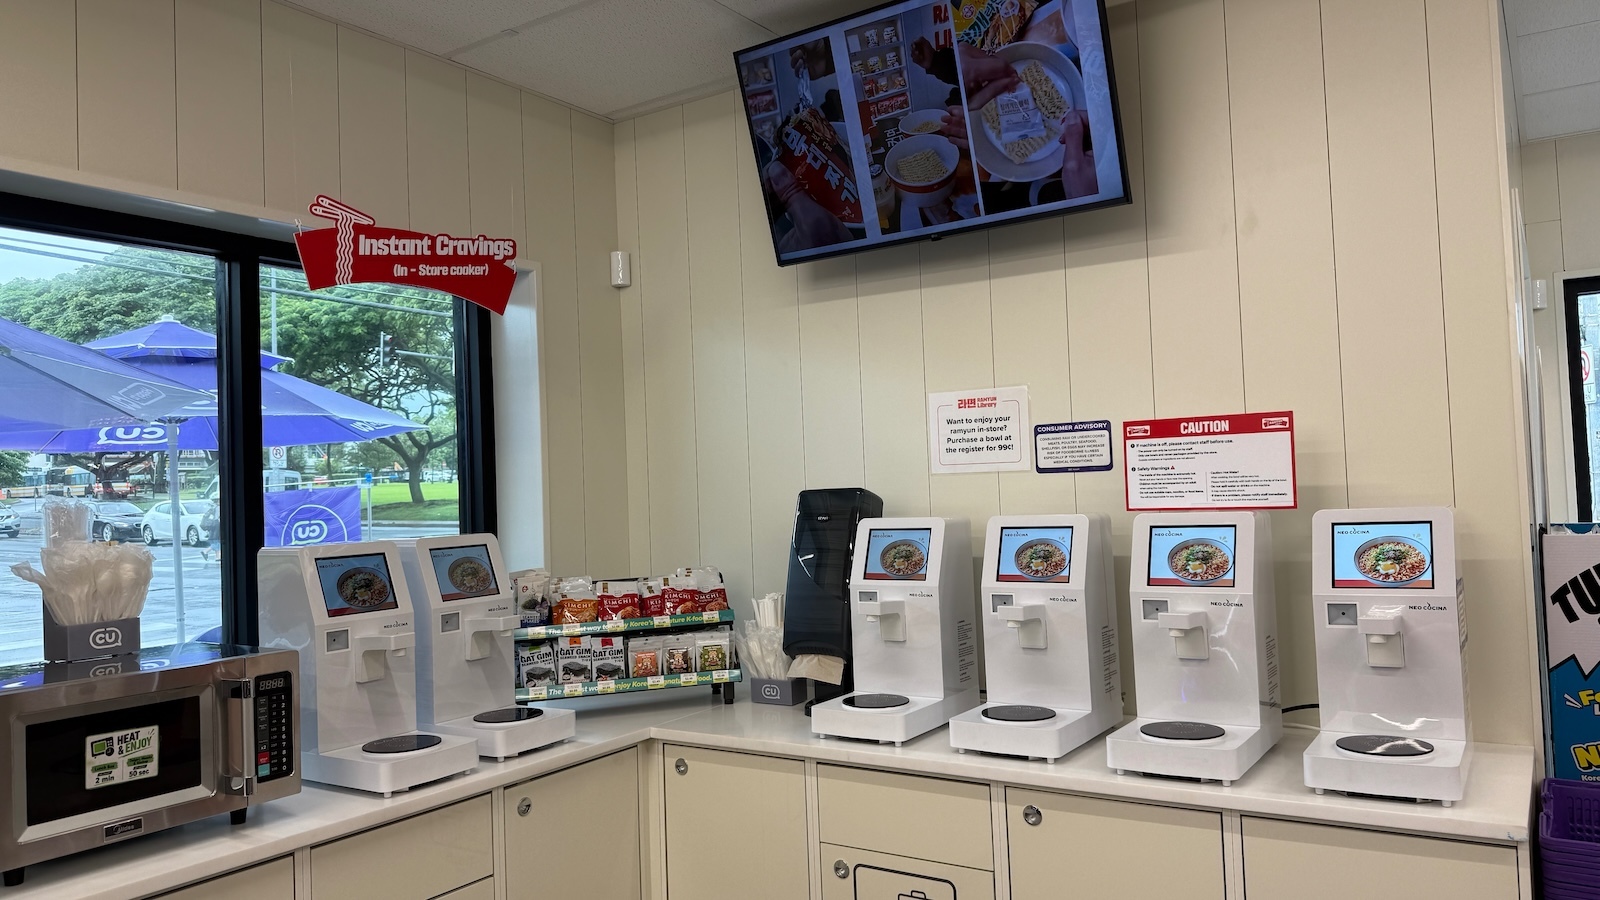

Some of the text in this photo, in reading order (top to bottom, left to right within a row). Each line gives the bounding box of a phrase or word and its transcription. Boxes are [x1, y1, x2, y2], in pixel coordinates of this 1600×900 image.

[358, 234, 514, 260] Instant Cravings
[394, 264, 408, 276] (In
[418, 264, 448, 276] Store
[450, 264, 489, 276] cooker)
[974, 416, 993, 424] enjoy
[1180, 420, 1230, 434] CAUTION
[96, 632, 116, 644] CU
[537, 652, 551, 660] GIM
[117, 730, 140, 745] HEAT
[118, 736, 152, 755] & ENJOY
